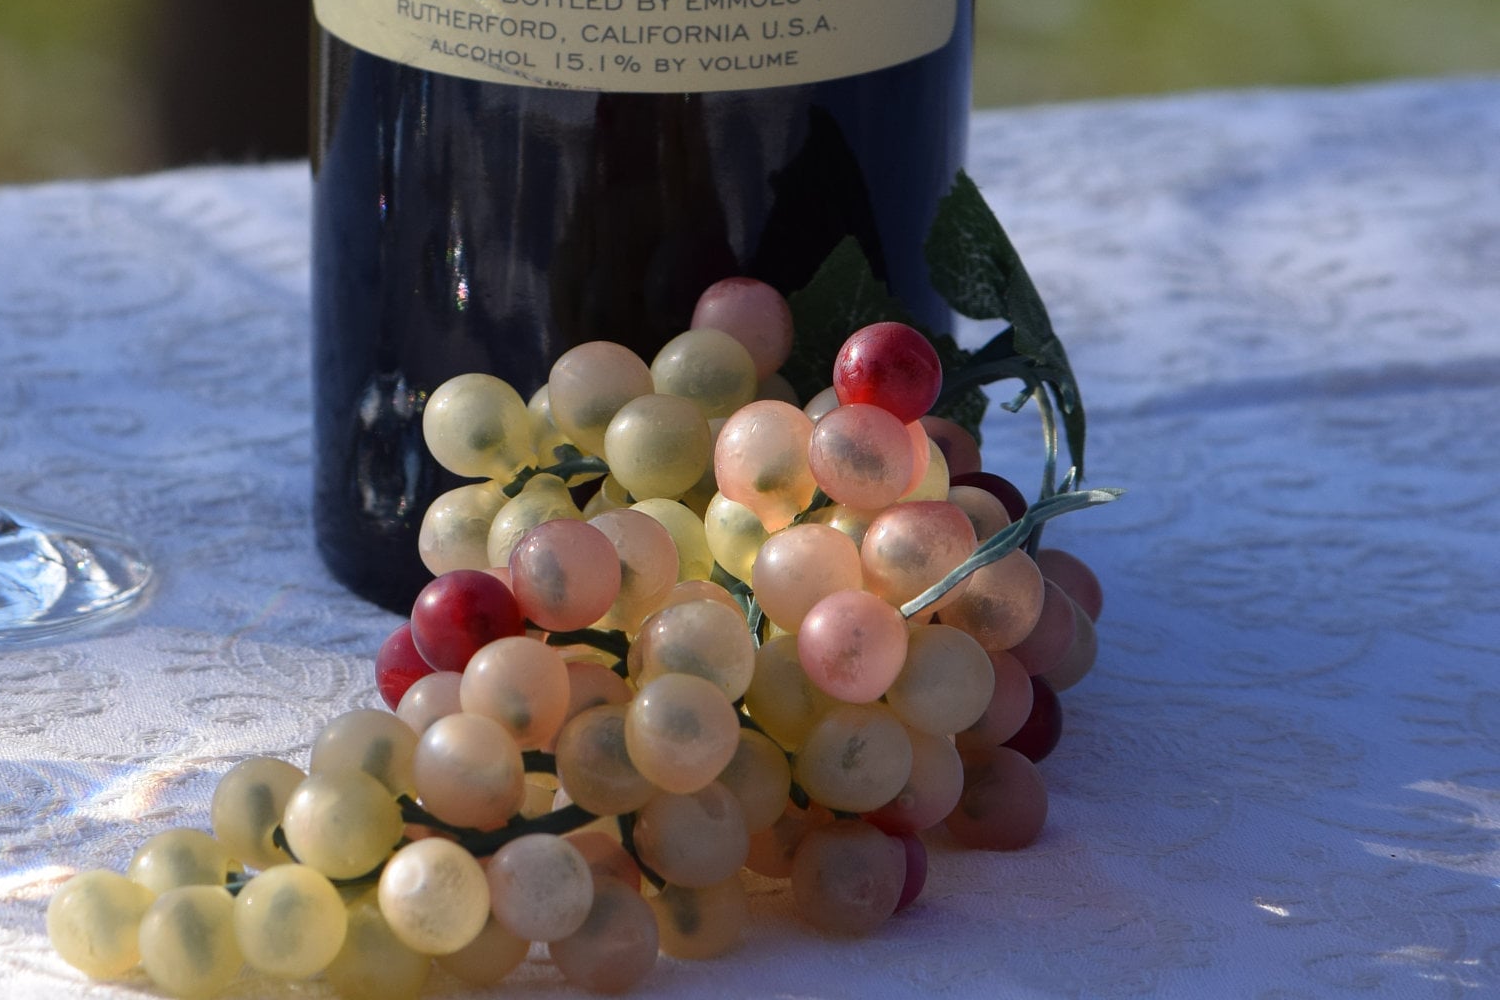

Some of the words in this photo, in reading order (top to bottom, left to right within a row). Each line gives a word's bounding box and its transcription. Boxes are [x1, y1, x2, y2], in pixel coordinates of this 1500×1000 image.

[580, 23, 750, 45] CALIFORNIA
[762, 14, 838, 40] U.S.A.
[430, 38, 536, 68] ALCOHOL
[555, 52, 642, 73] 15.1%
[654, 57, 687, 73] BY
[699, 50, 799, 73] VOLUME
